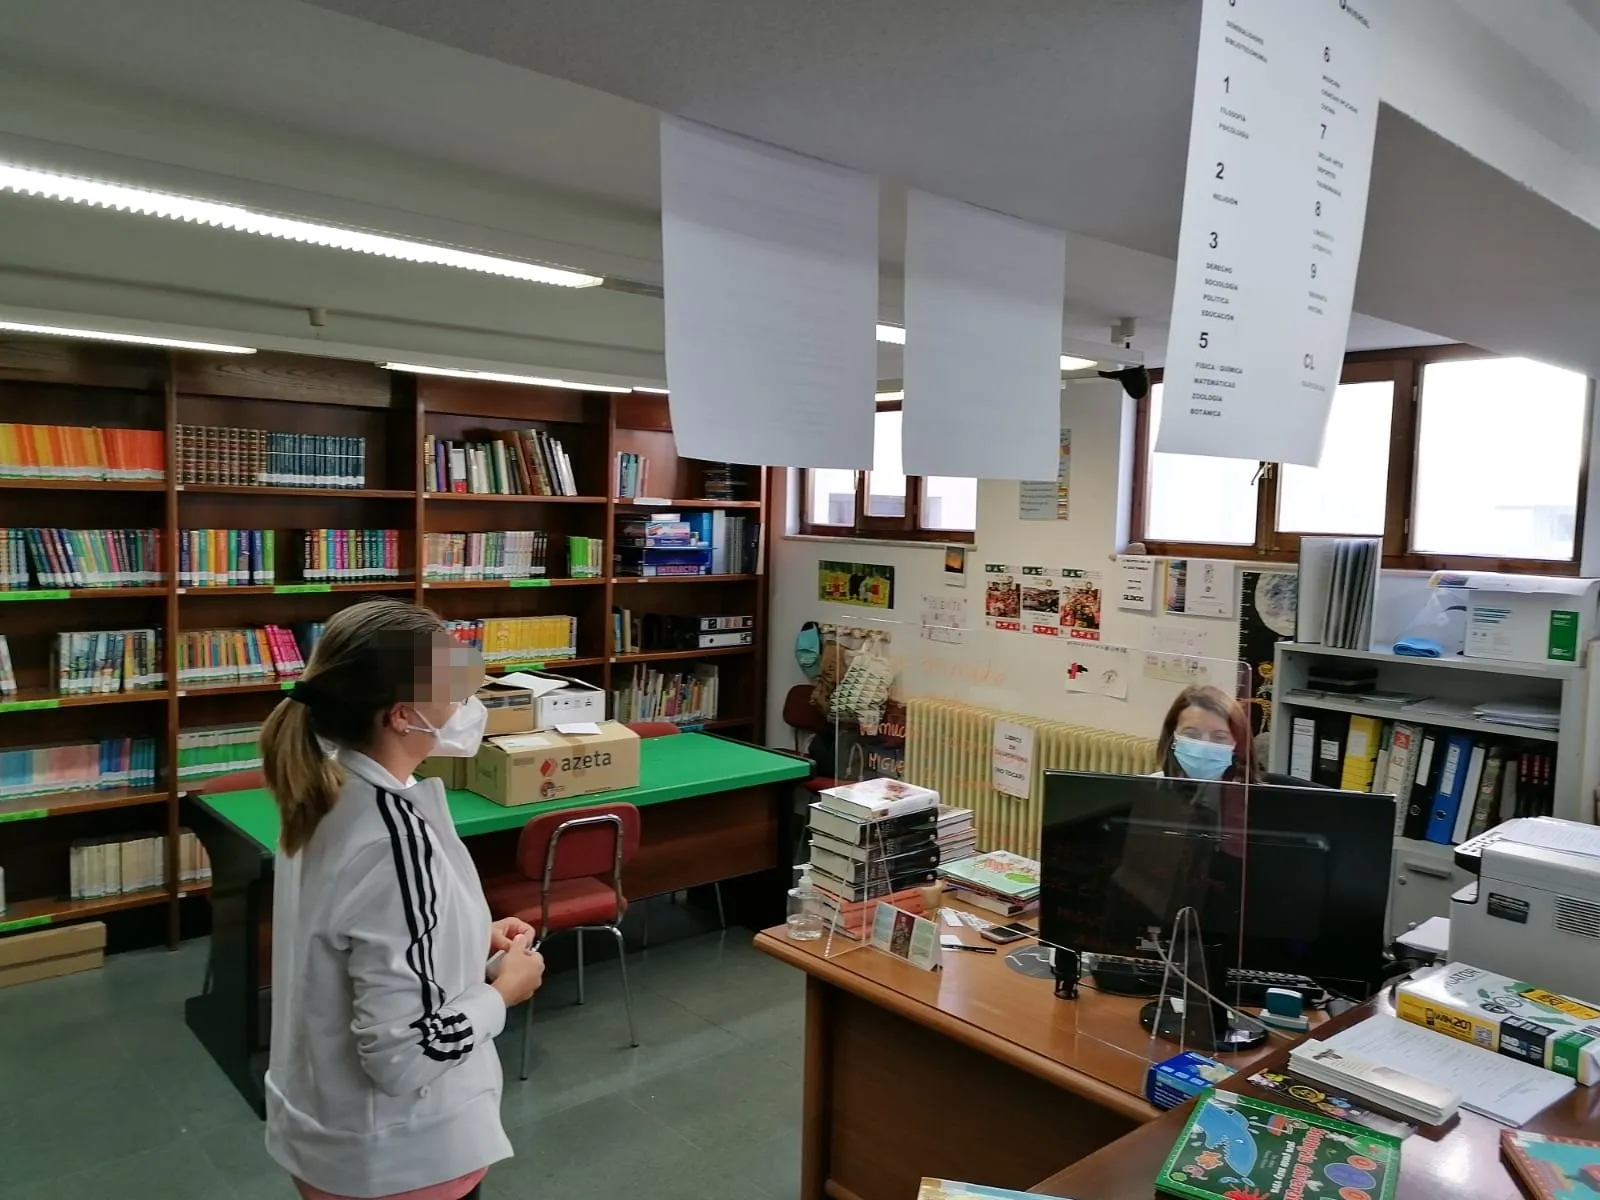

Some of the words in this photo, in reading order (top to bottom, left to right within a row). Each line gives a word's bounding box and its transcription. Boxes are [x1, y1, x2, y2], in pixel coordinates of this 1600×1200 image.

[1324, 46, 1330, 63] 6
[1223, 75, 1230, 94] 1
[1320, 123, 1328, 140] 7
[1215, 162, 1225, 180] 2
[1314, 201, 1321, 217] 8
[1208, 232, 1219, 250] 3
[1310, 263, 1317, 279] 9
[1198, 332, 1209, 349] 5
[560, 750, 614, 772] azeta
